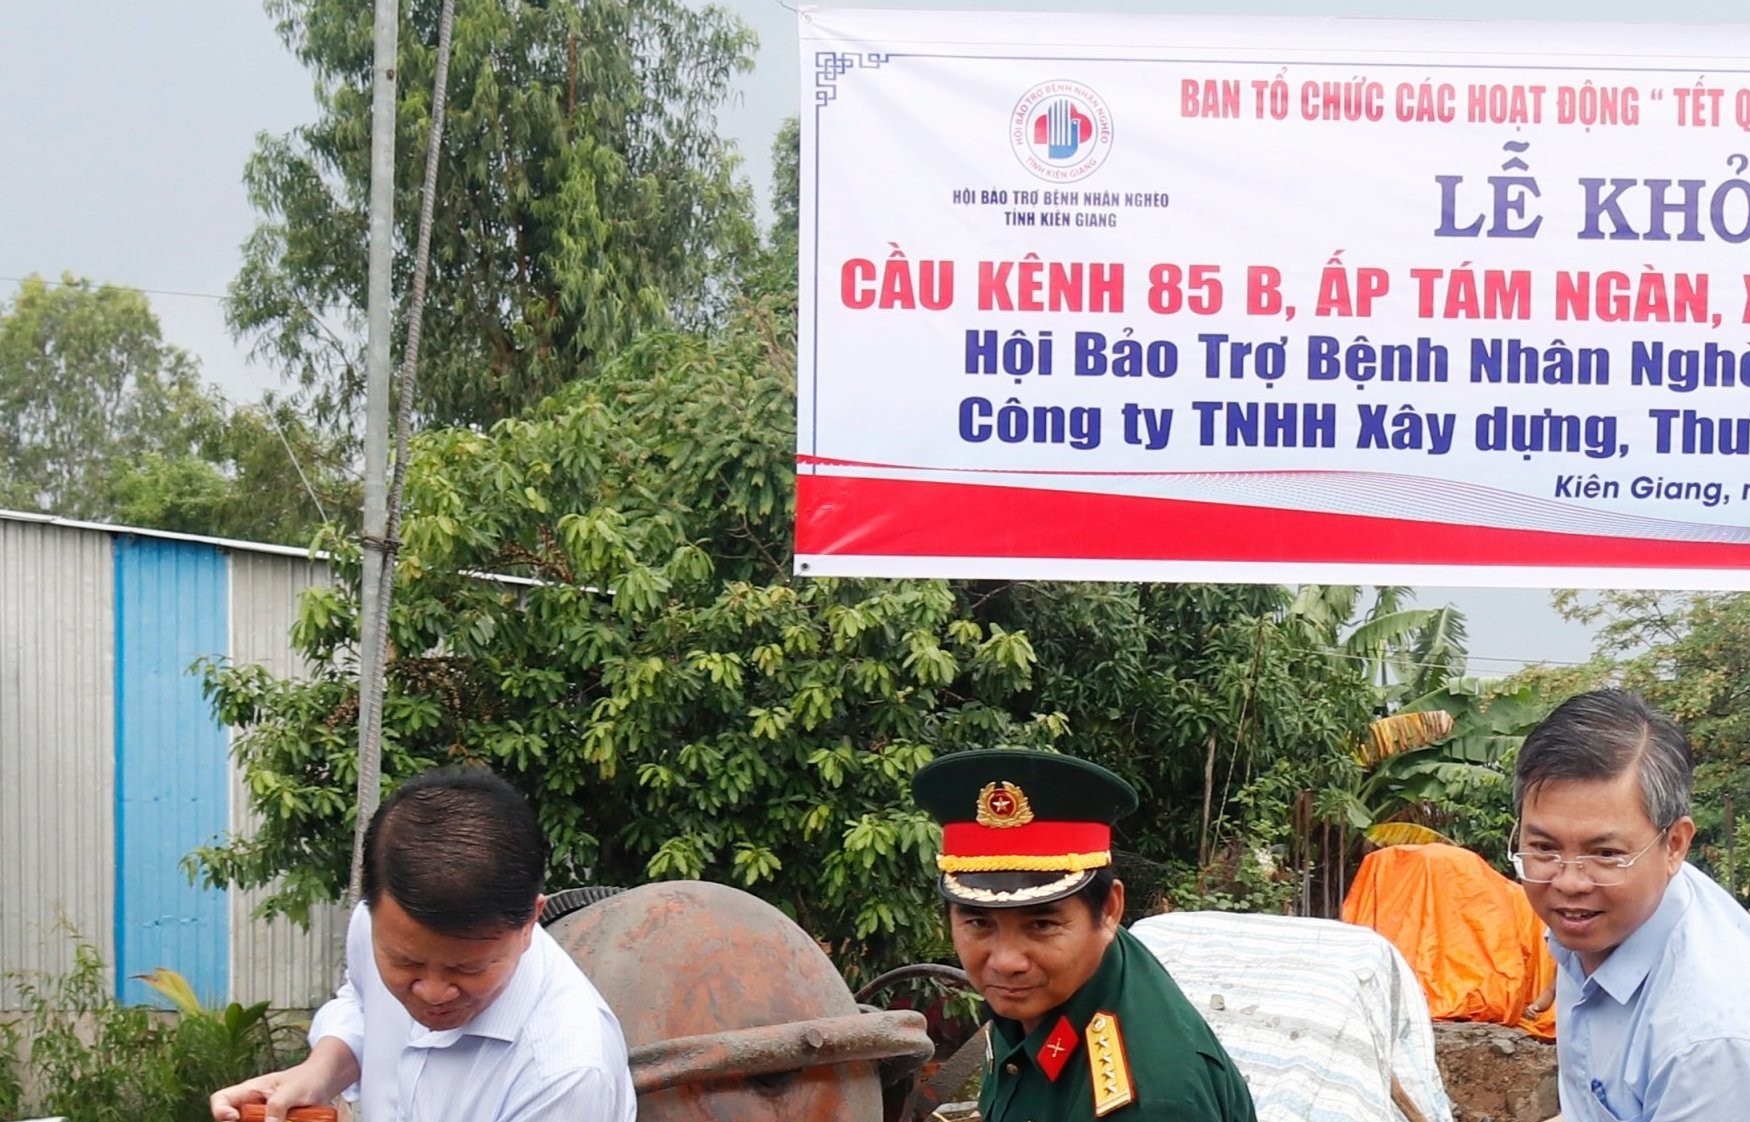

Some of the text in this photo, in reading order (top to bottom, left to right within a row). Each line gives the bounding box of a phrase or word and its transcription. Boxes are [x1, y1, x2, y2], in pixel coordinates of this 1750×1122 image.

[1181, 79, 1240, 118] BAN
[1251, 67, 1289, 120] TỔ
[1301, 76, 1384, 122] CHỨC
[1396, 77, 1455, 123] CÁC
[1468, 84, 1546, 131] HOẠT
[1557, 80, 1639, 132] ĐỘNG
[1673, 76, 1724, 127] TẾT
[953, 187, 1169, 208] HỘI BẢO TRỢ BỆNH NHÂN NGHÈO
[1004, 208, 1117, 228] TỈNH KIÊN GIANG
[1434, 141, 1543, 239] LỄ
[841, 242, 955, 311] CẦU
[978, 252, 1125, 313] KÊNH
[1148, 263, 1223, 316] 85
[1247, 265, 1296, 322] B,
[1315, 249, 1390, 318] ẤP
[1410, 261, 1531, 320] TÁM
[1555, 264, 1722, 329] NGÀN,
[965, 329, 1053, 385] Hội
[1074, 328, 1178, 378] Bảo
[1198, 333, 1288, 389] Trợ
[1307, 335, 1448, 390] Bệnh
[1470, 338, 1610, 385] Nhân
[959, 396, 1101, 450] Công
[1121, 403, 1174, 450] ty
[1192, 401, 1336, 448] TNHH
[1356, 404, 1456, 455] Xây
[1475, 406, 1629, 461] dựng,
[1554, 474, 1620, 501] Kiên
[1630, 476, 1730, 506] Giang,
